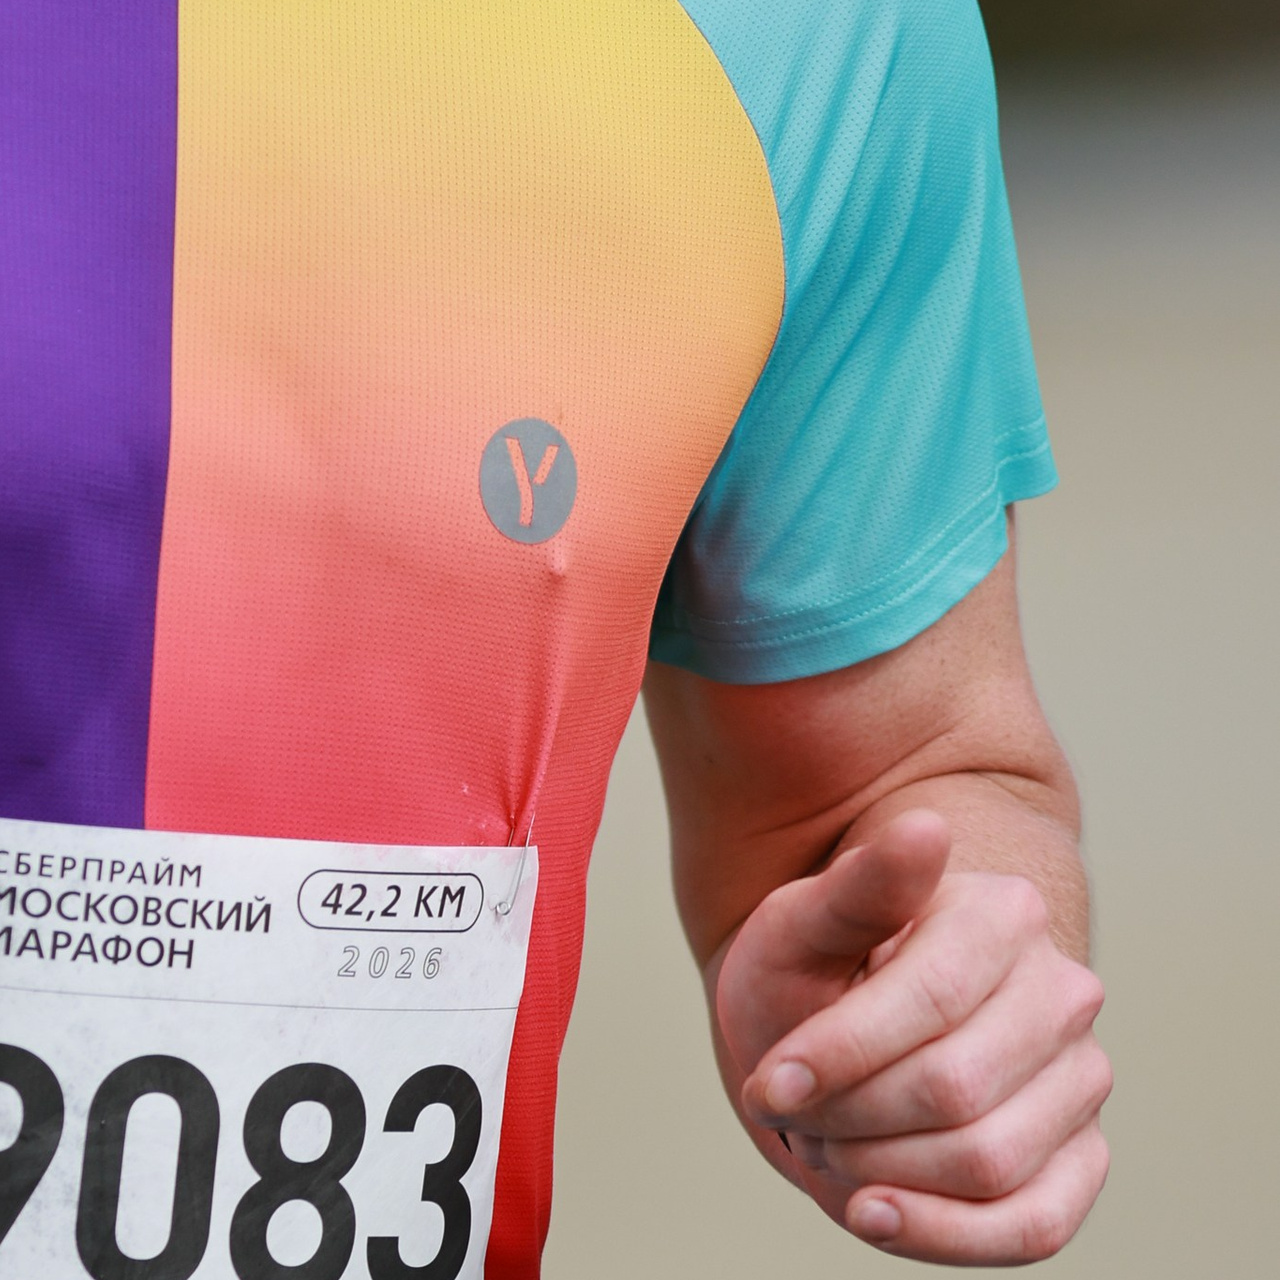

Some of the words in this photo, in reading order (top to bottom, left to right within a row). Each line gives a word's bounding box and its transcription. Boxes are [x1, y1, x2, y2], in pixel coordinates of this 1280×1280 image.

[321, 883, 402, 922] 42,2
[413, 886, 466, 918] КМ
[337, 946, 442, 979] 2026
